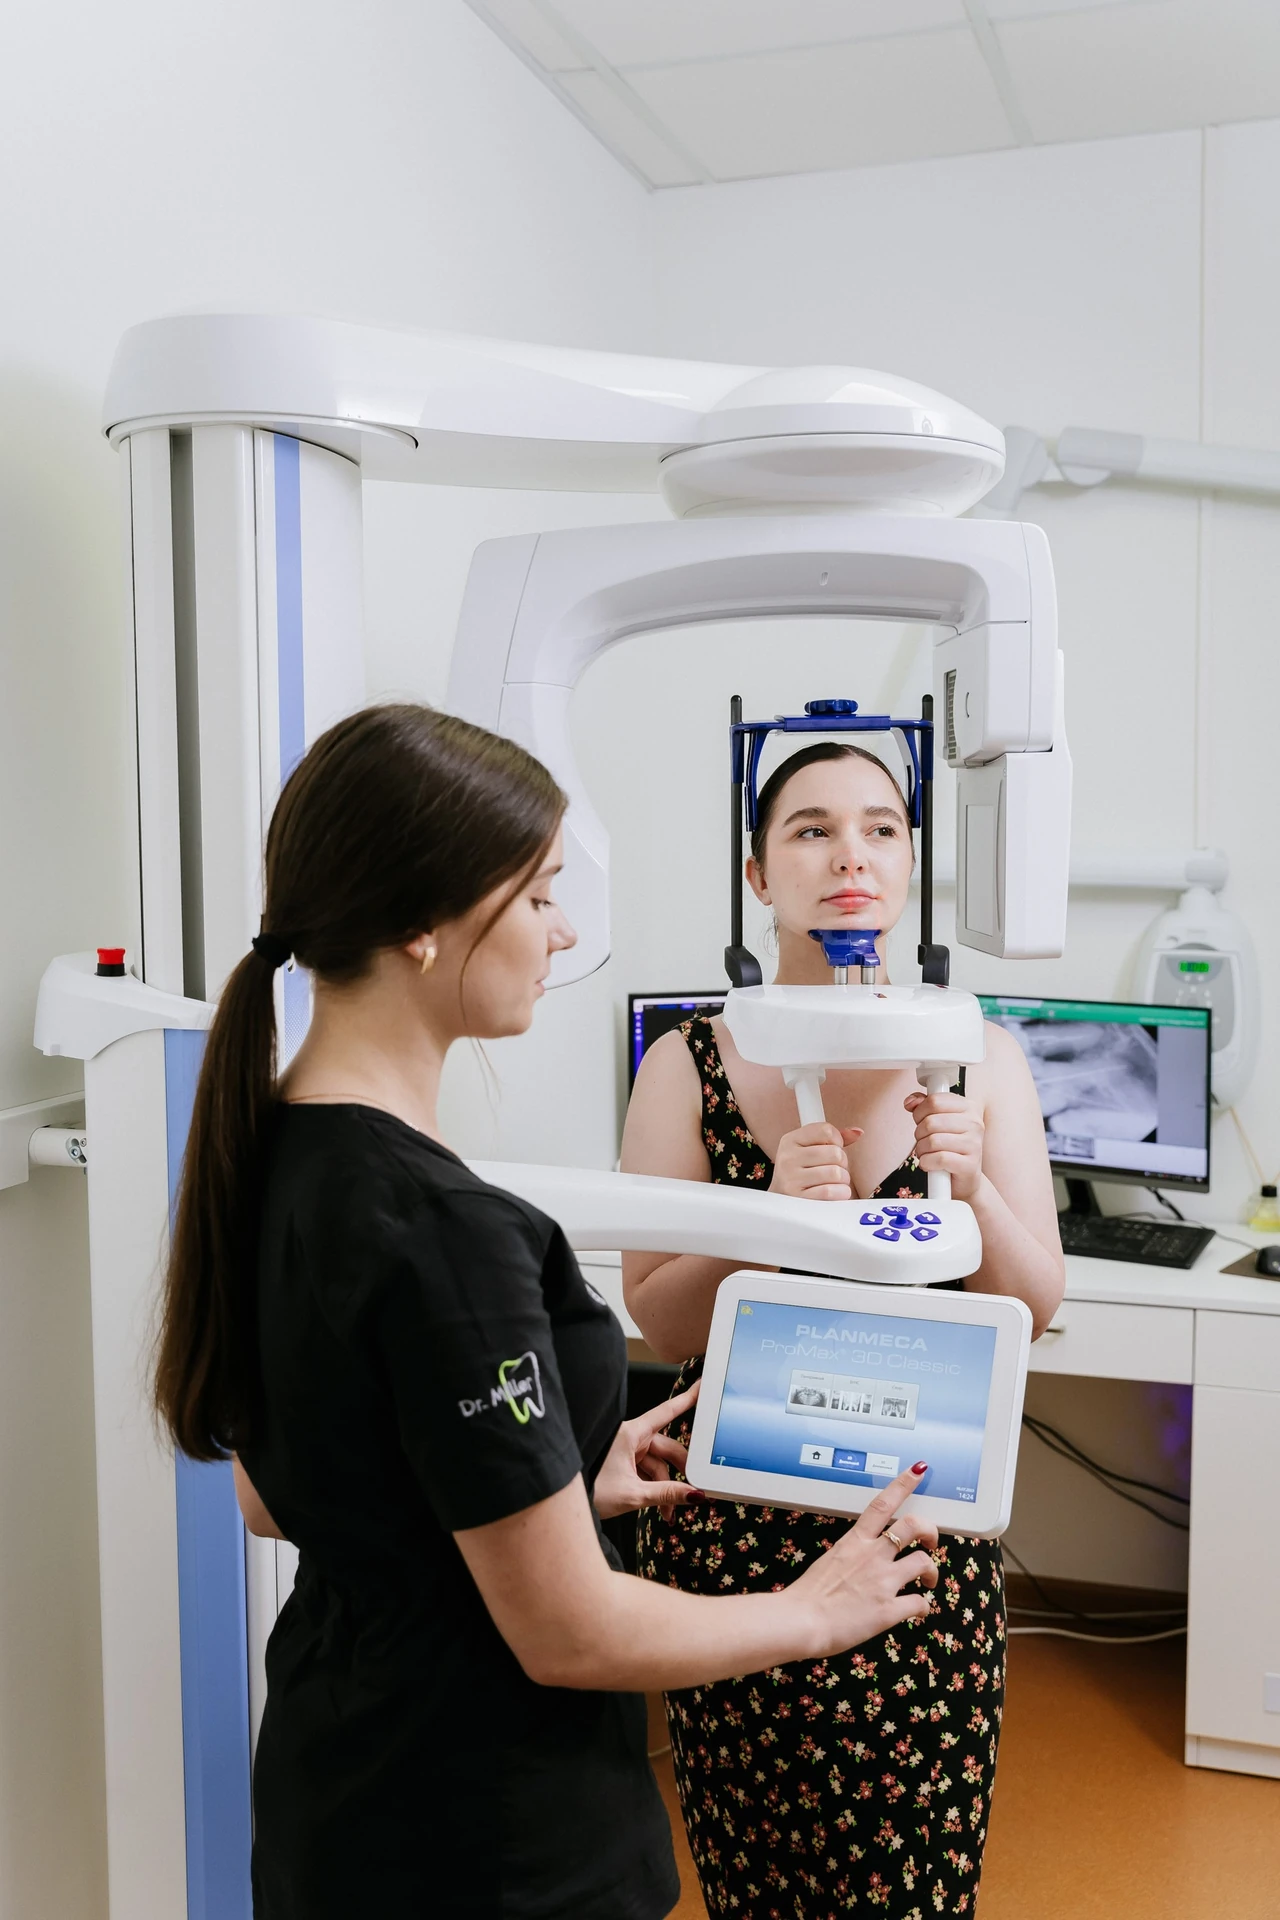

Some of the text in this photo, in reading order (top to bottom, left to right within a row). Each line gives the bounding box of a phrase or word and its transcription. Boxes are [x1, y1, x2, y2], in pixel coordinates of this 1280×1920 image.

[796, 1324, 928, 1351] PLANMECA
[850, 1349, 882, 1366] 3D
[886, 1353, 962, 1376] Classic
[458, 1398, 489, 1418] Dr.
